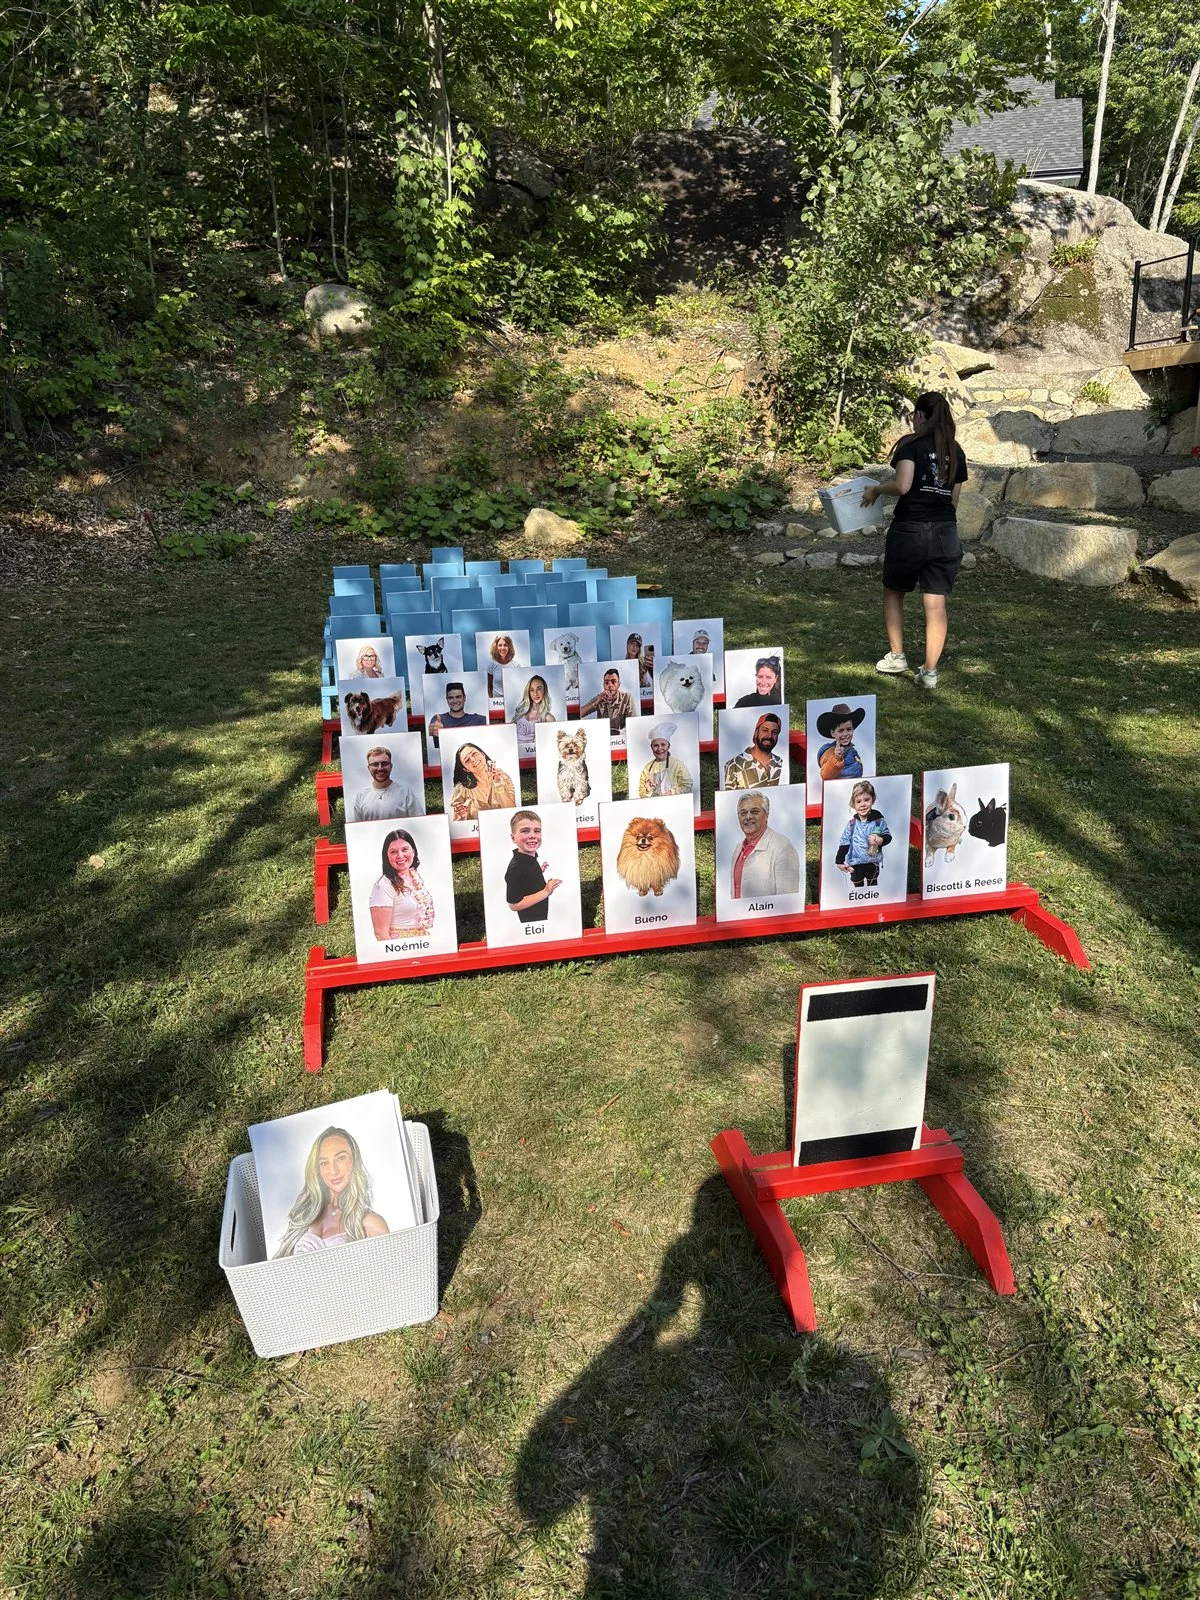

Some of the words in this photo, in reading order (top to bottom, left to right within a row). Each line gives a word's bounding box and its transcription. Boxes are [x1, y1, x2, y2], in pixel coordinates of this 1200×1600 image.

[926, 881, 963, 893] Biscotti
[965, 880, 972, 889] &
[974, 877, 1003, 887] Reese
[848, 890, 880, 901] Élodie
[748, 902, 774, 912] Alain
[634, 914, 668, 925] Bueno
[524, 924, 545, 936] Éloi
[385, 940, 430, 953] Noémie
